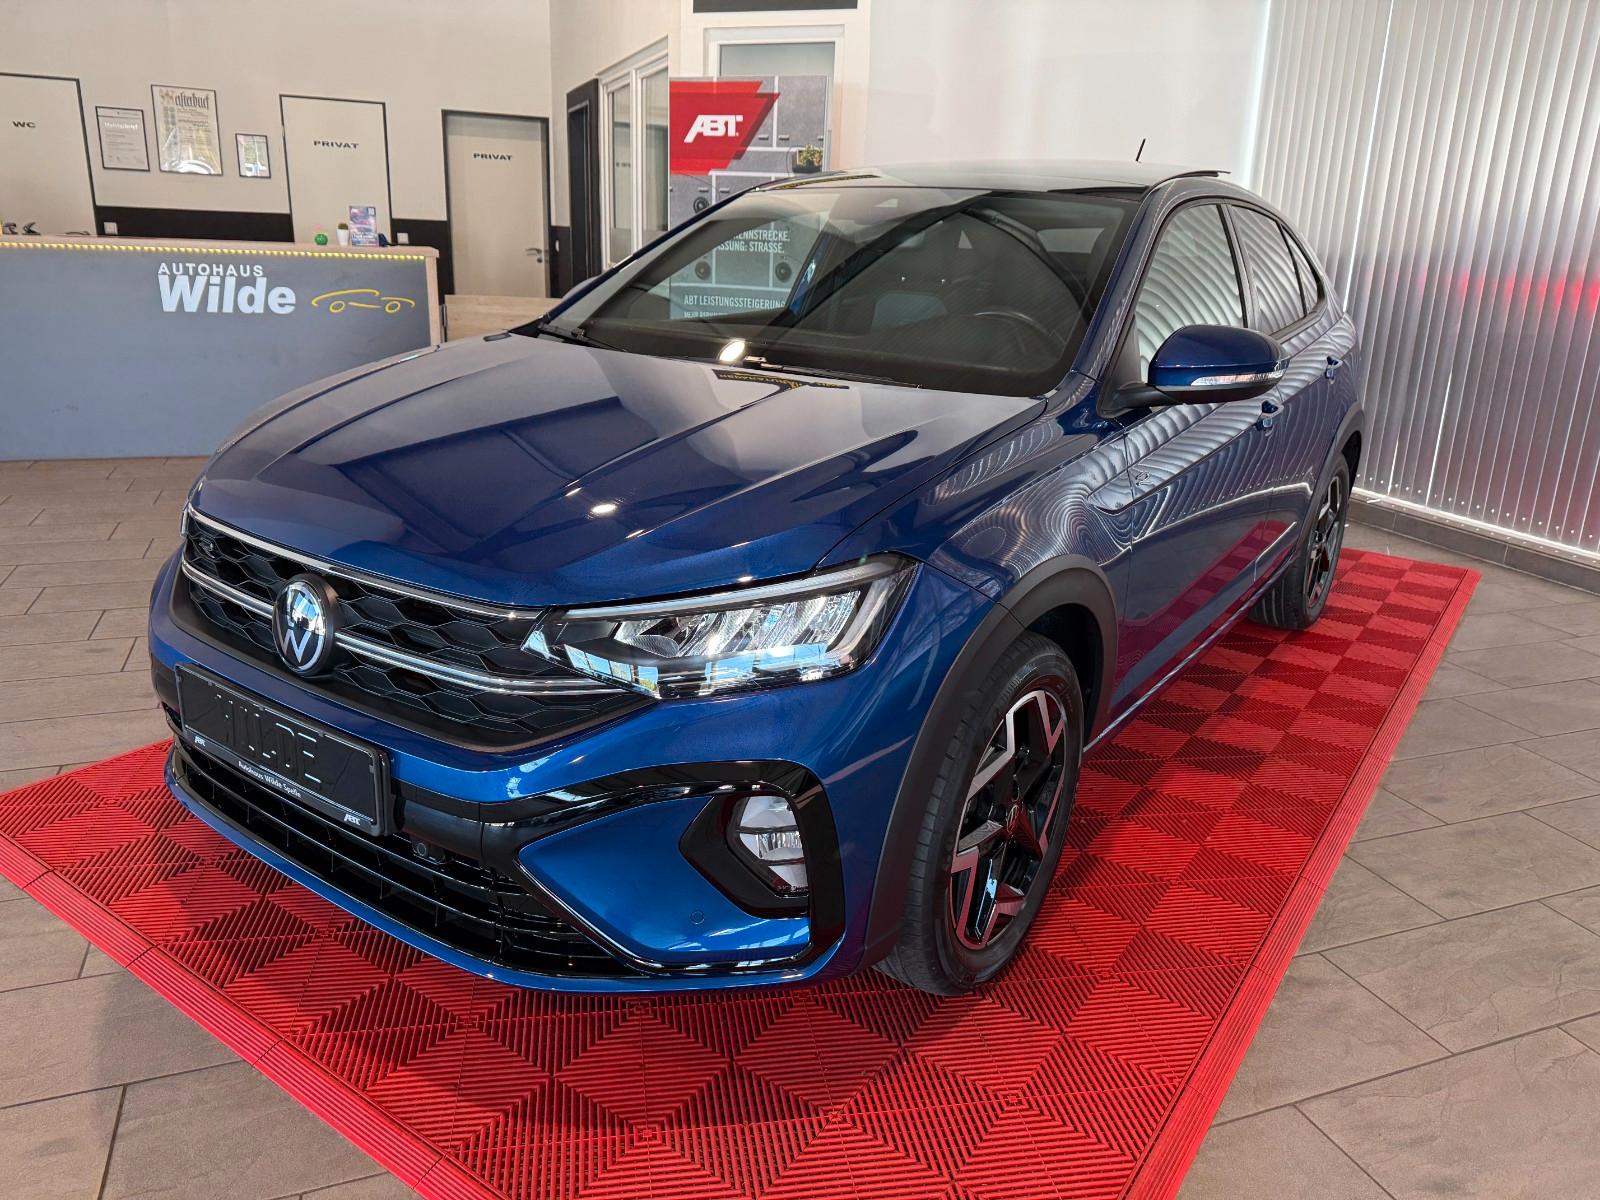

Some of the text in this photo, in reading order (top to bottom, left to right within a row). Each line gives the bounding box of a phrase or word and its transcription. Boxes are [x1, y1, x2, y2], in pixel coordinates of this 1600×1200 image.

[13, 120, 37, 129] WC
[684, 114, 743, 143] ABT
[313, 139, 360, 150] PRIVAT
[473, 152, 513, 161] PRIVAT
[749, 241, 785, 254] STRASSE.
[158, 262, 264, 277] AUTOHAUS
[158, 274, 296, 314] Wilde
[684, 295, 698, 305] ABT
[264, 774, 283, 789] Wilde
[343, 813, 361, 826] ABT
